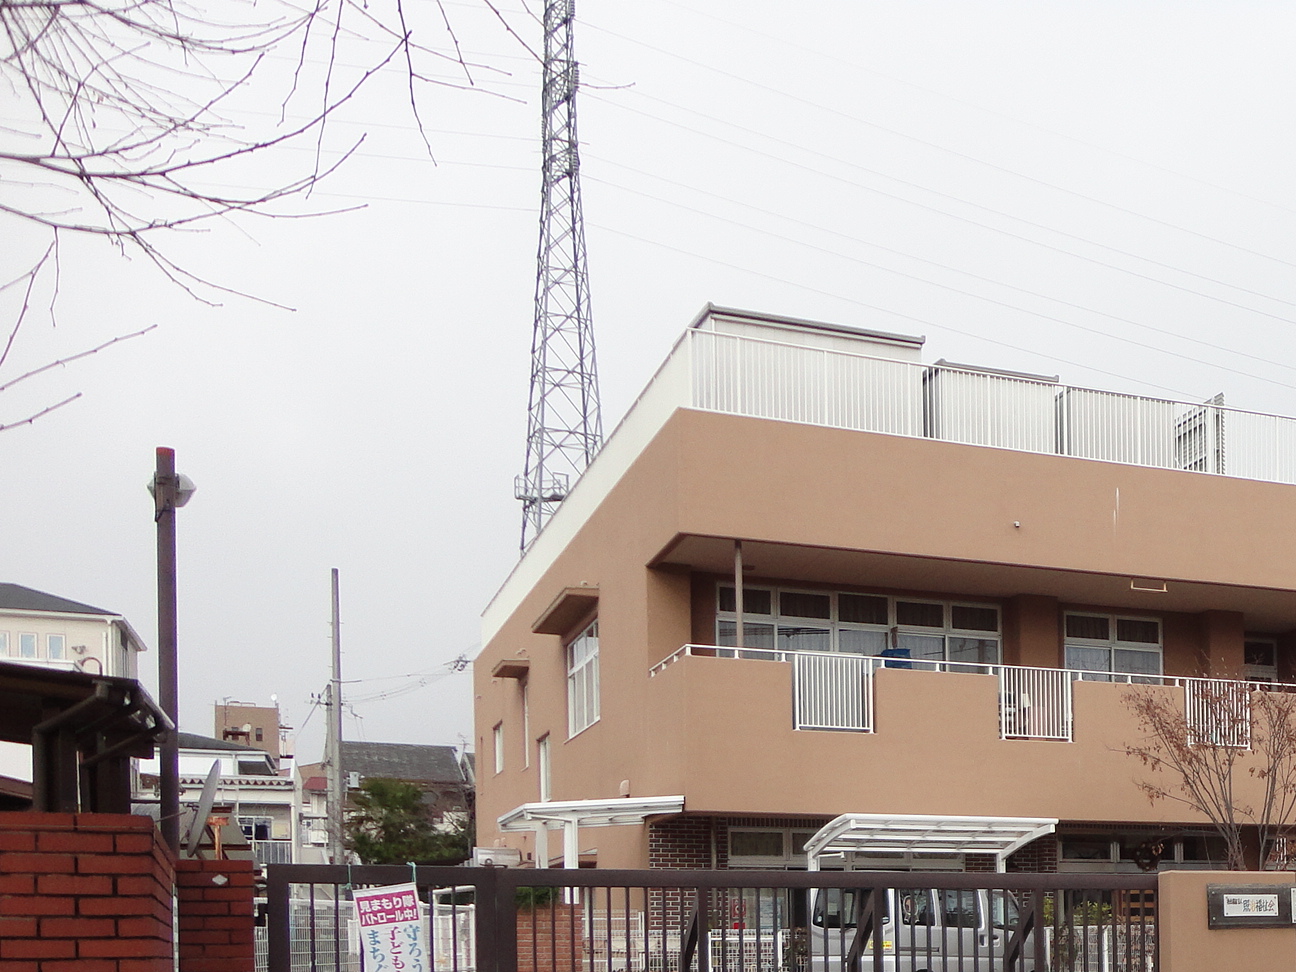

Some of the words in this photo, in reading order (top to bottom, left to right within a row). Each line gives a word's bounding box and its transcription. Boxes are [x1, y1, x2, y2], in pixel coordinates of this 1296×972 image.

[359, 895, 415, 913] 見まもり隊
